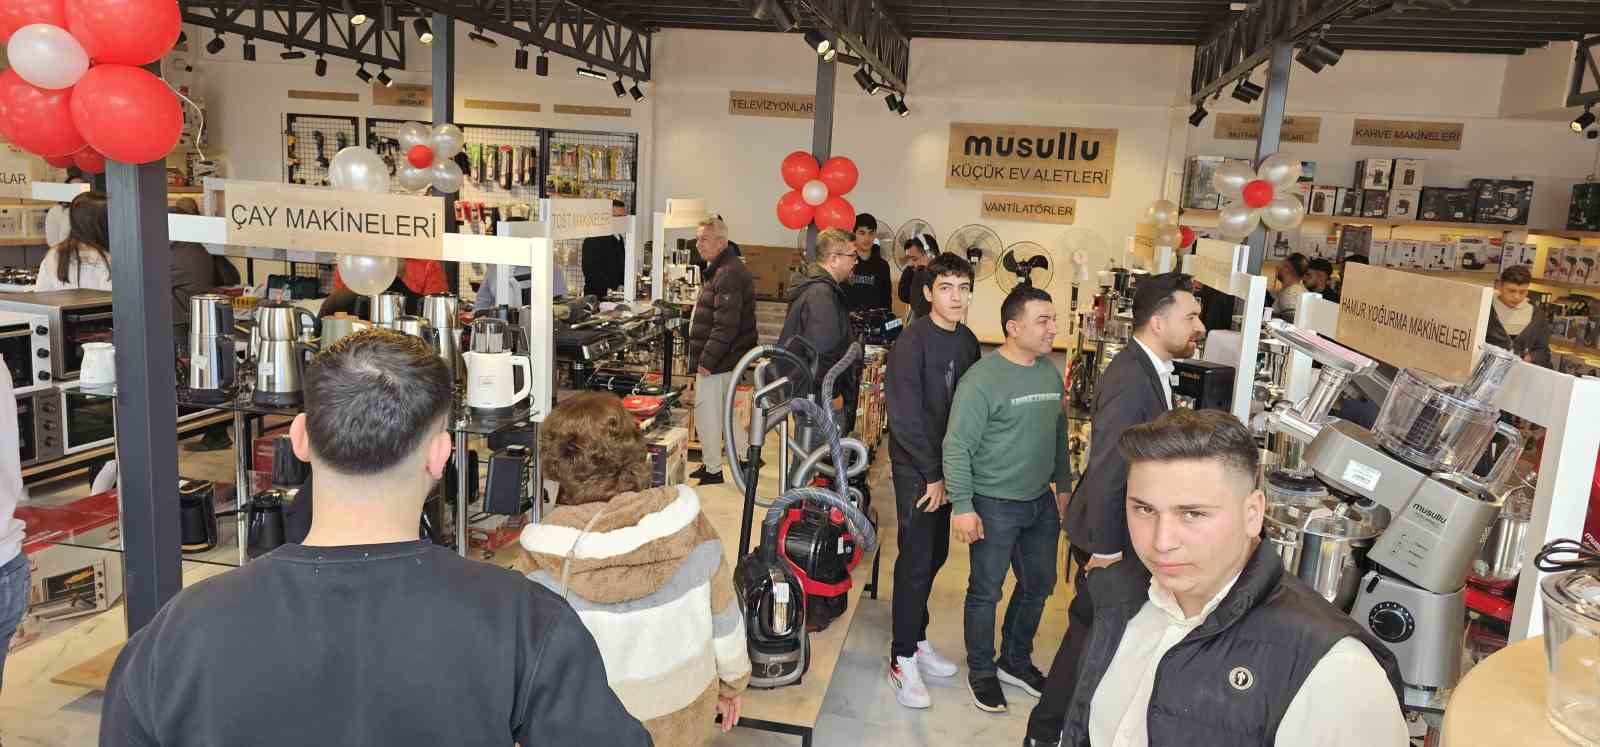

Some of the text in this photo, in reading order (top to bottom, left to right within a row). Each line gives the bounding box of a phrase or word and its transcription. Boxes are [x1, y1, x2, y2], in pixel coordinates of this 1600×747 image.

[964, 132, 1100, 161] musullu
[1355, 128, 1392, 140] KAHVE
[951, 163, 1109, 185] KÜÇÜK EV ALETLERİ
[231, 204, 436, 238] ÇAY MAKİNELERİ
[1341, 297, 1472, 351] HAMUR YOĞURMA MAKİNELERİ
[1412, 502, 1448, 524] musullu
